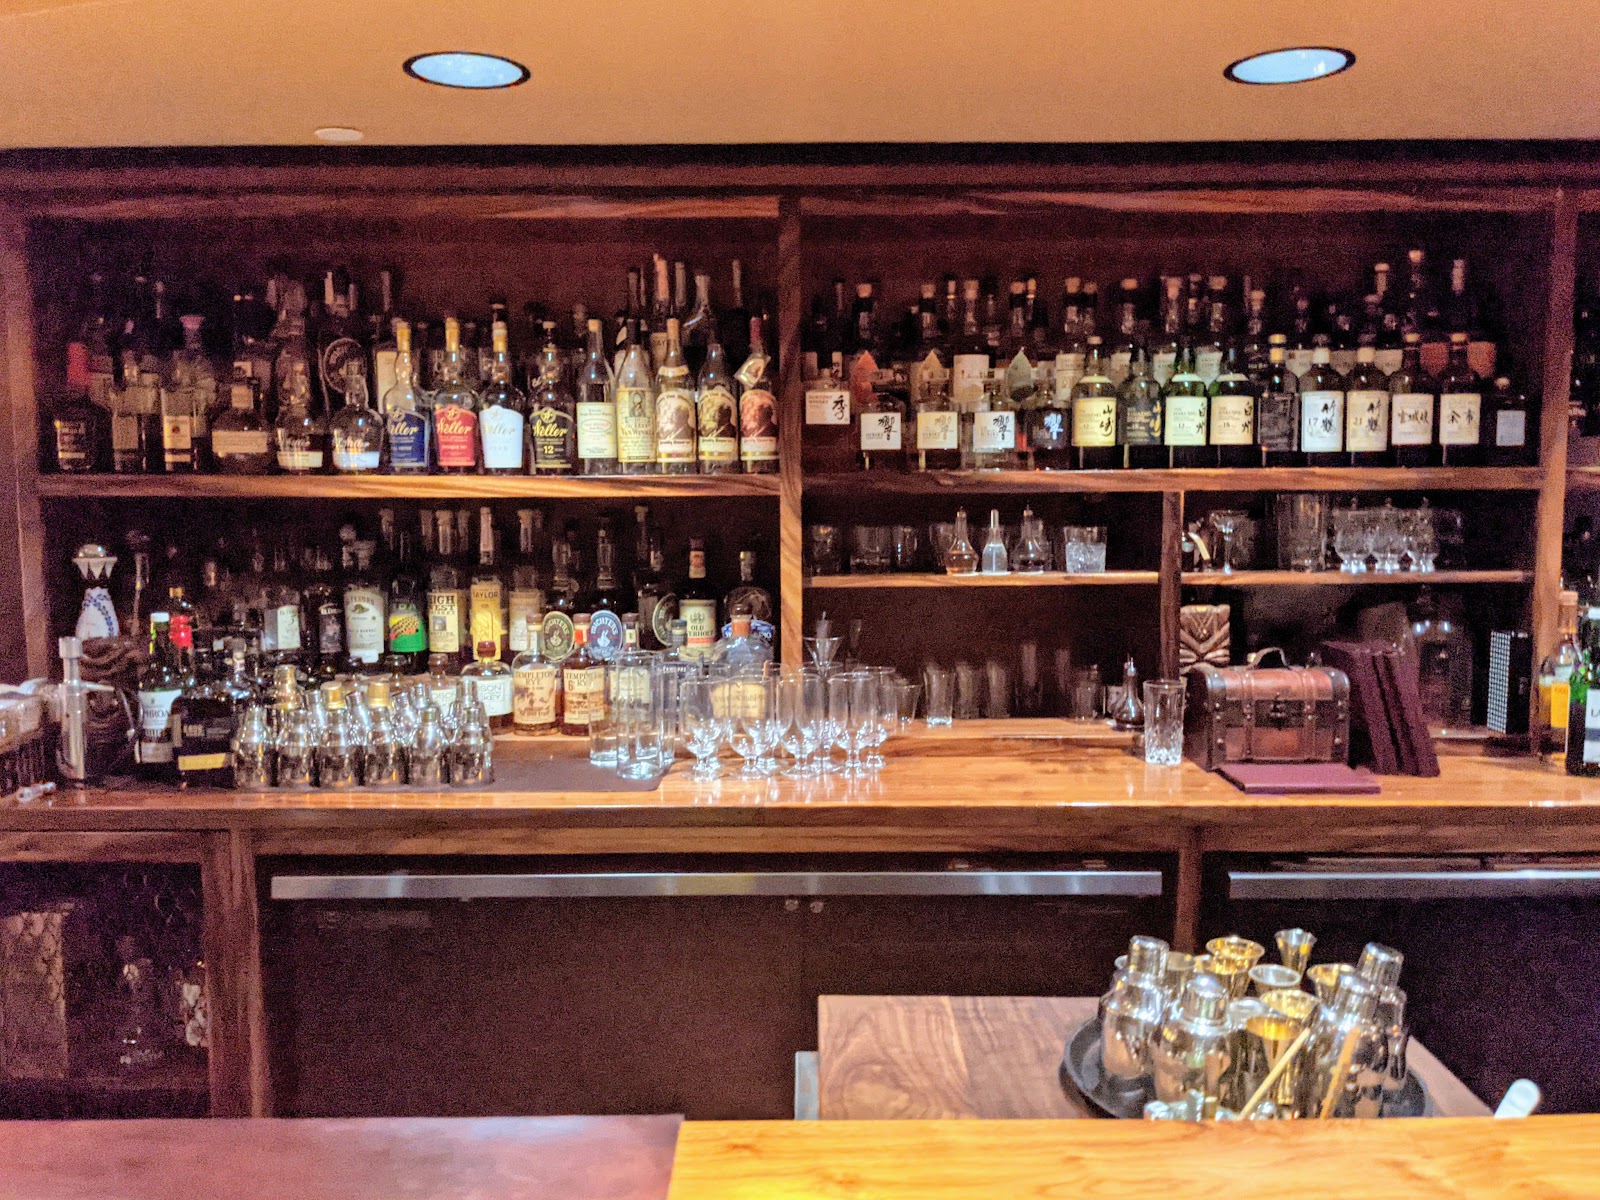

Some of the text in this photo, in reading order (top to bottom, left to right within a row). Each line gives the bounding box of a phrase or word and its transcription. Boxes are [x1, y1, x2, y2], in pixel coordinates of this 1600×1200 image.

[437, 418, 472, 435] Weller
[532, 419, 568, 437] Weller
[543, 445, 554, 454] 12
